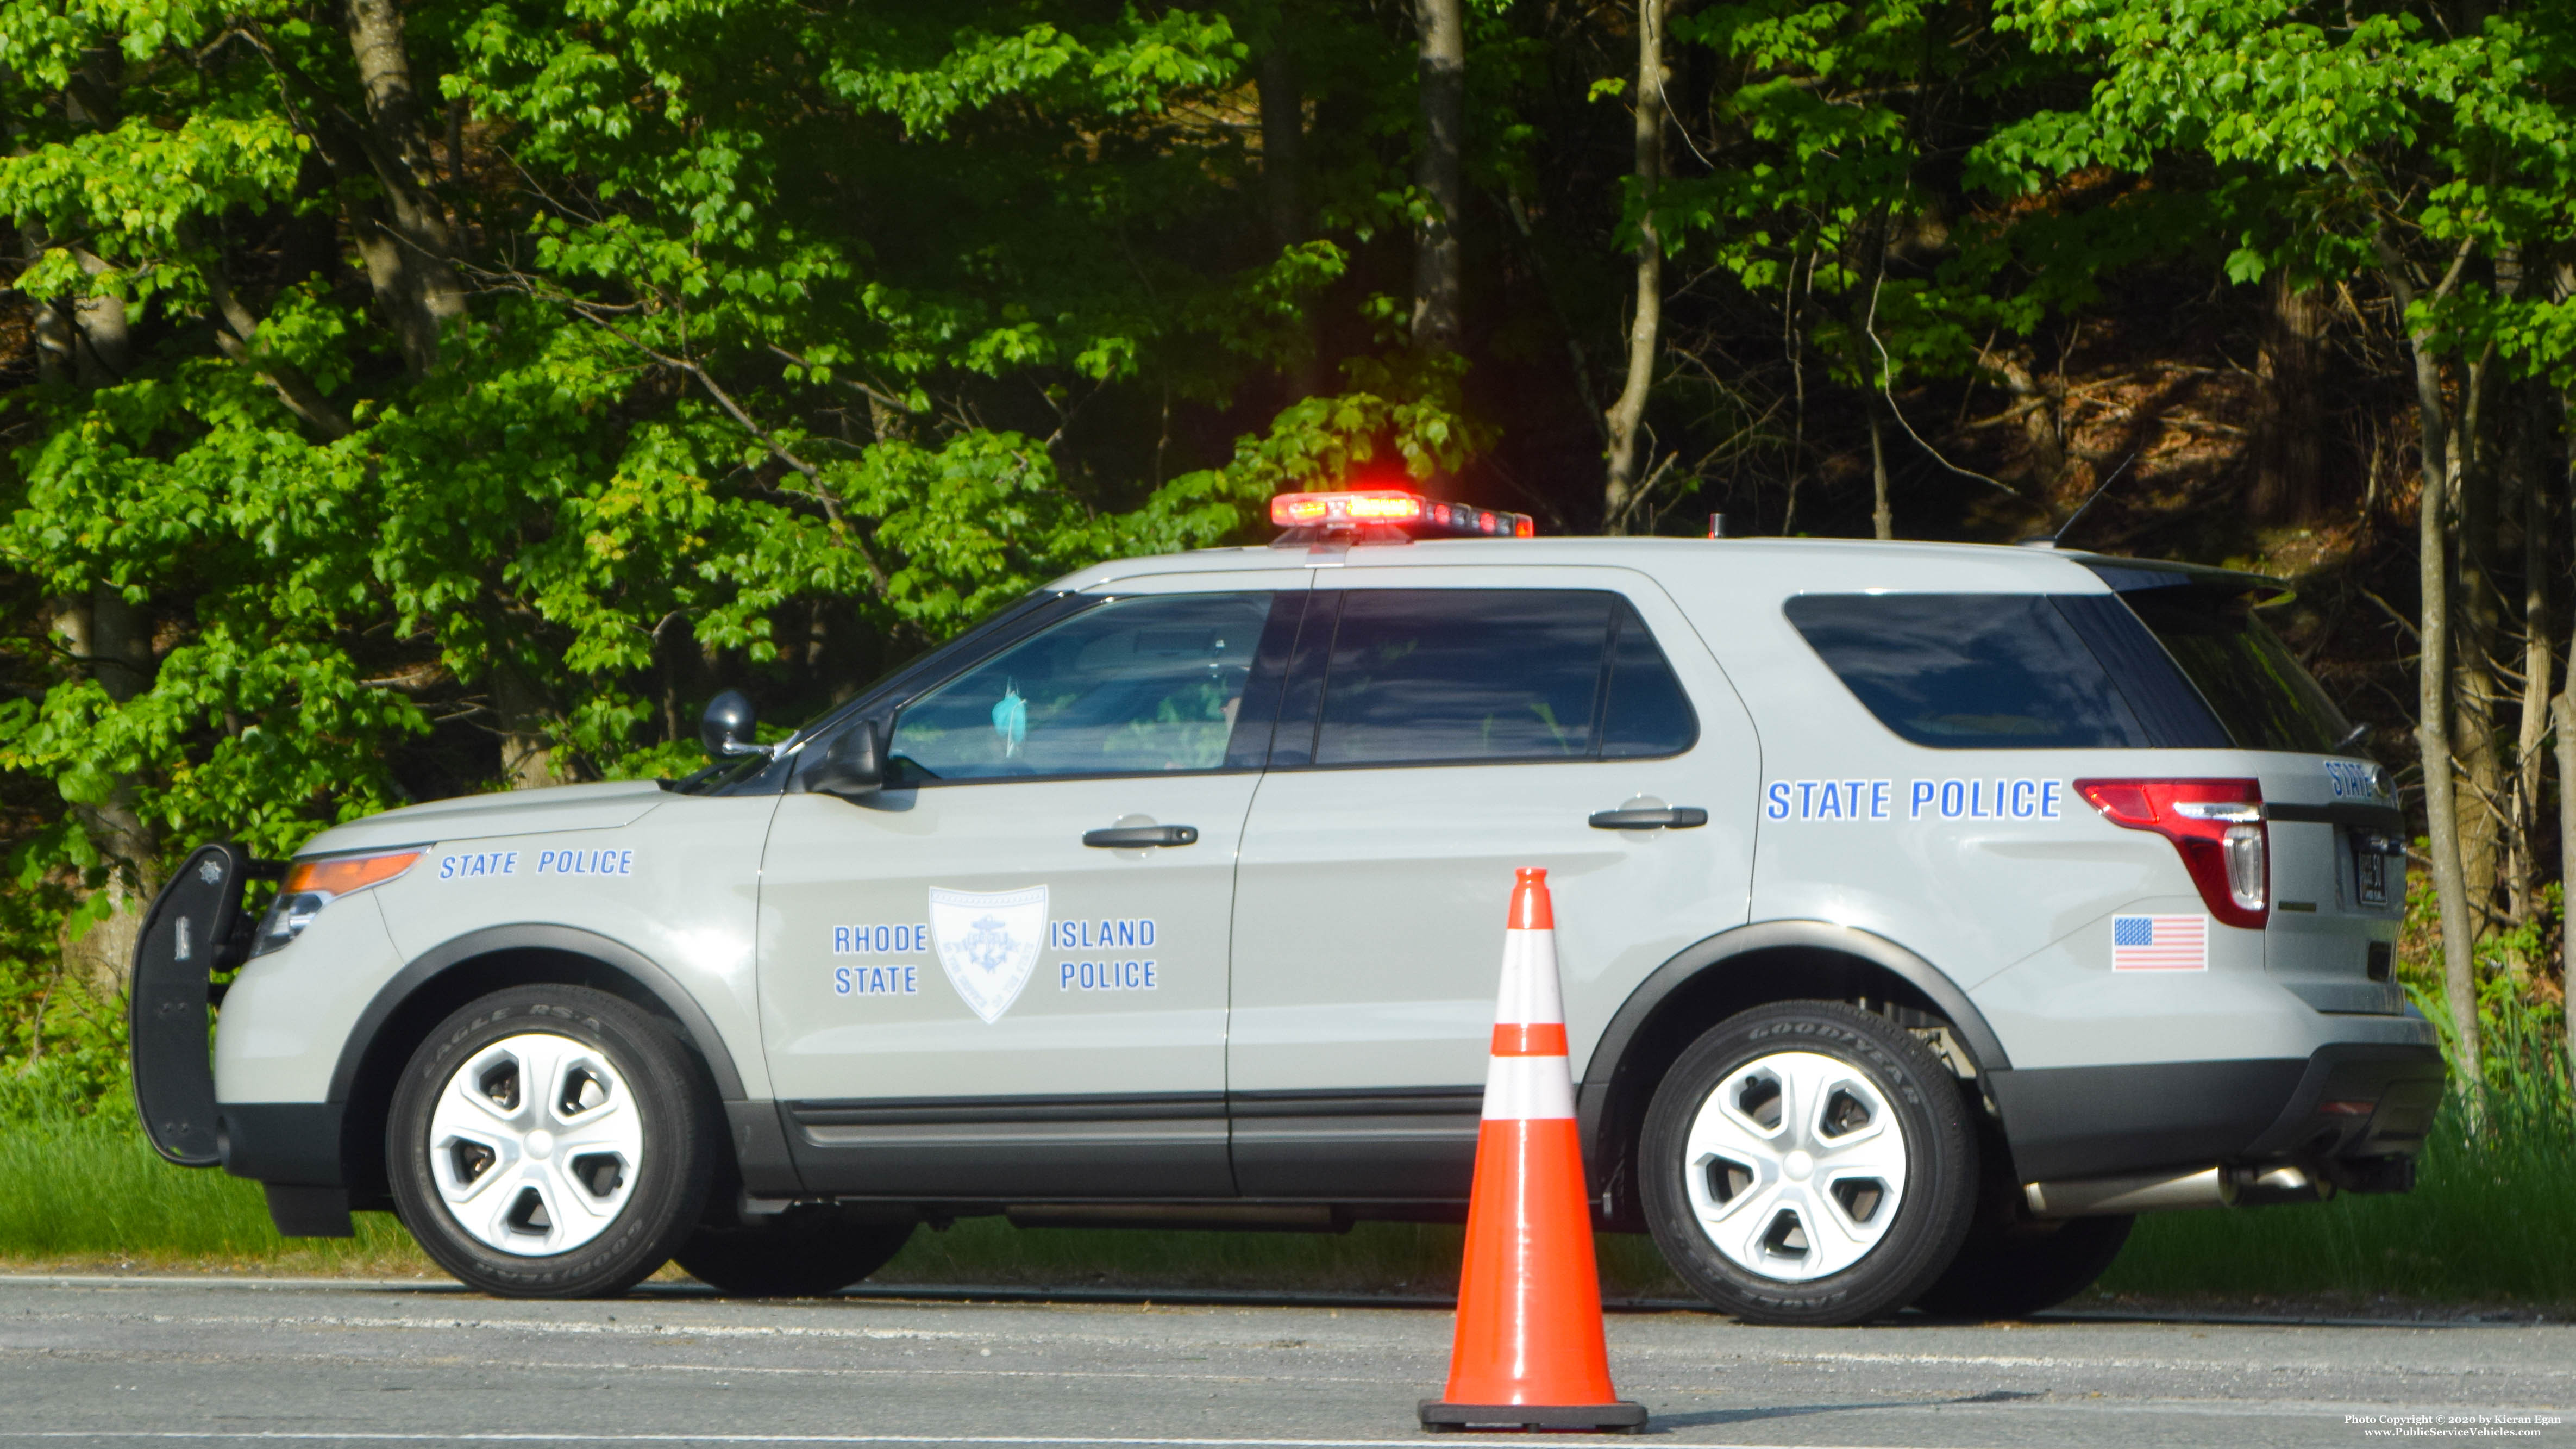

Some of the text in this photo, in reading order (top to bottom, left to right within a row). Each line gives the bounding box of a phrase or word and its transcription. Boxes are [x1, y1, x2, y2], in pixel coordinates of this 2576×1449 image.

[2325, 761, 2371, 797] STATE
[1767, 780, 2060, 819] STATE POLICE
[439, 850, 632, 879] STATE POLICE
[833, 920, 1155, 953] RHODE ISLAND
[835, 966, 917, 994] STATE
[1060, 960, 1156, 989] POLICE
[1748, 1022, 1920, 1106] GOODYEAR
